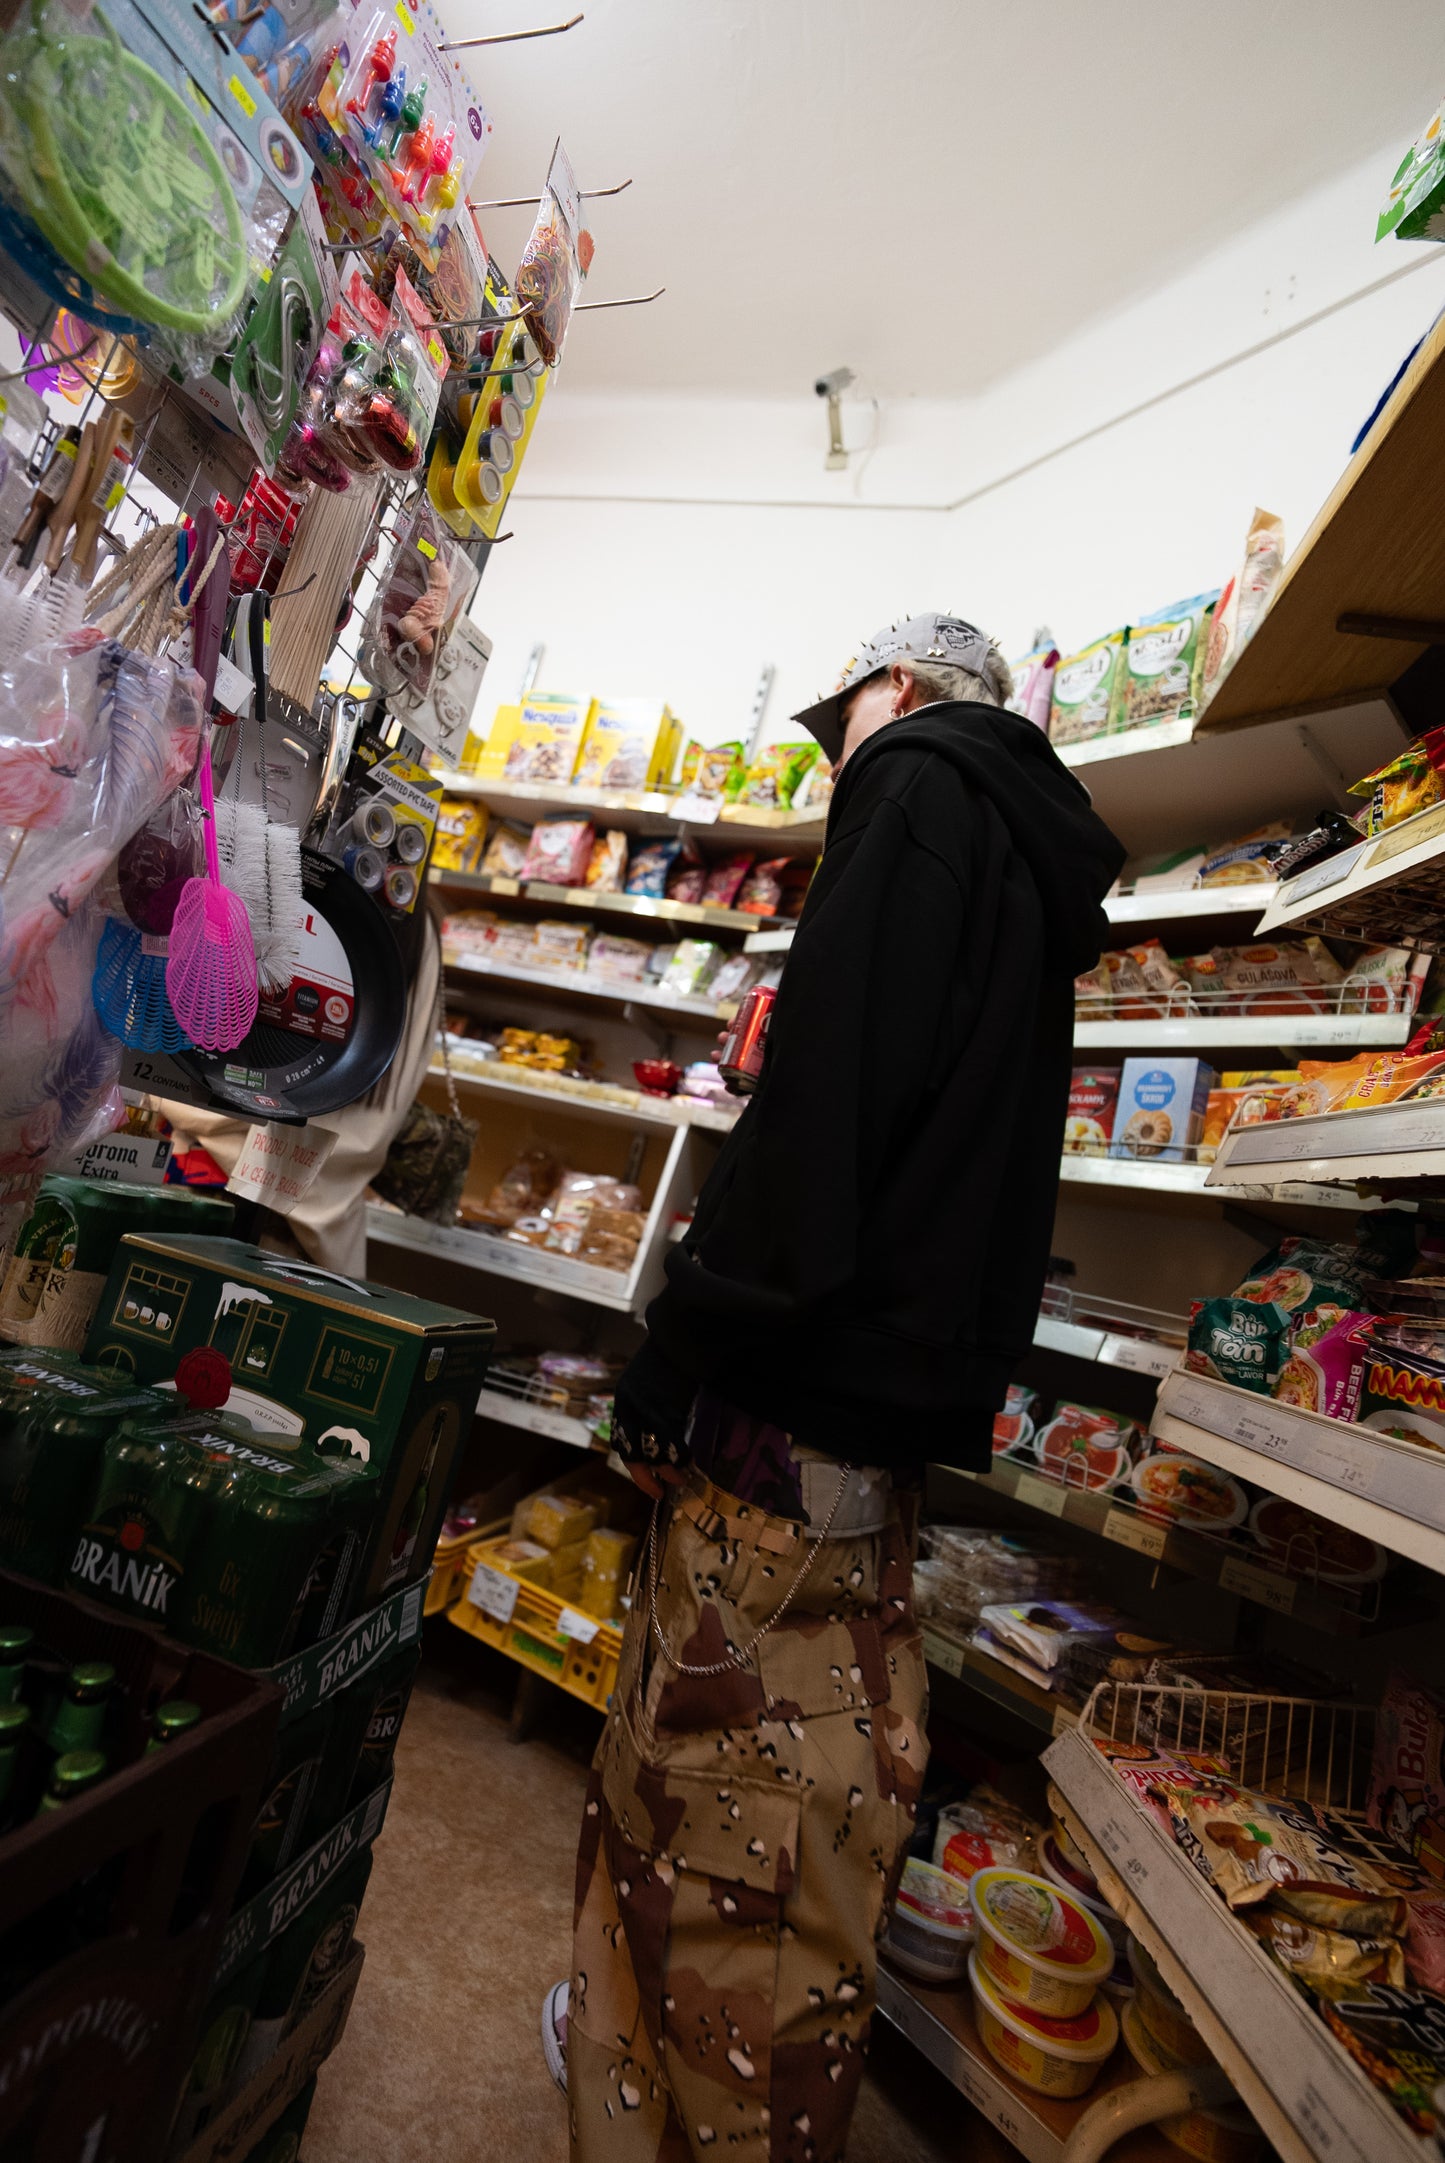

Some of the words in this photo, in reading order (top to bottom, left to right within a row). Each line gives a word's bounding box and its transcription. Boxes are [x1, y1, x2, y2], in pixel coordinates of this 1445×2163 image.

[198, 387, 220, 408] 5PCS
[375, 769, 408, 796] ASSORTED
[407, 788, 421, 805] PVC
[419, 795, 436, 814] TAPE
[132, 1061, 154, 1081] 12
[152, 1076, 191, 1093] CONTAINS
[156, 1144, 166, 1158] 6
[254, 1133, 284, 1157] PRODEJ
[241, 1165, 249, 1177] V
[1211, 1328, 1266, 1364] Tôm
[1238, 1371, 1265, 1381] LAVOR
[1349, 1365, 1363, 1403] BEEF
[189, 1432, 296, 1474] BRANÍK
[1264, 1434, 1281, 1448] 23
[70, 1537, 177, 1615] BRANÍK
[318, 1604, 393, 1698] BRANÍK
[268, 1815, 356, 1934] BRANÍK
